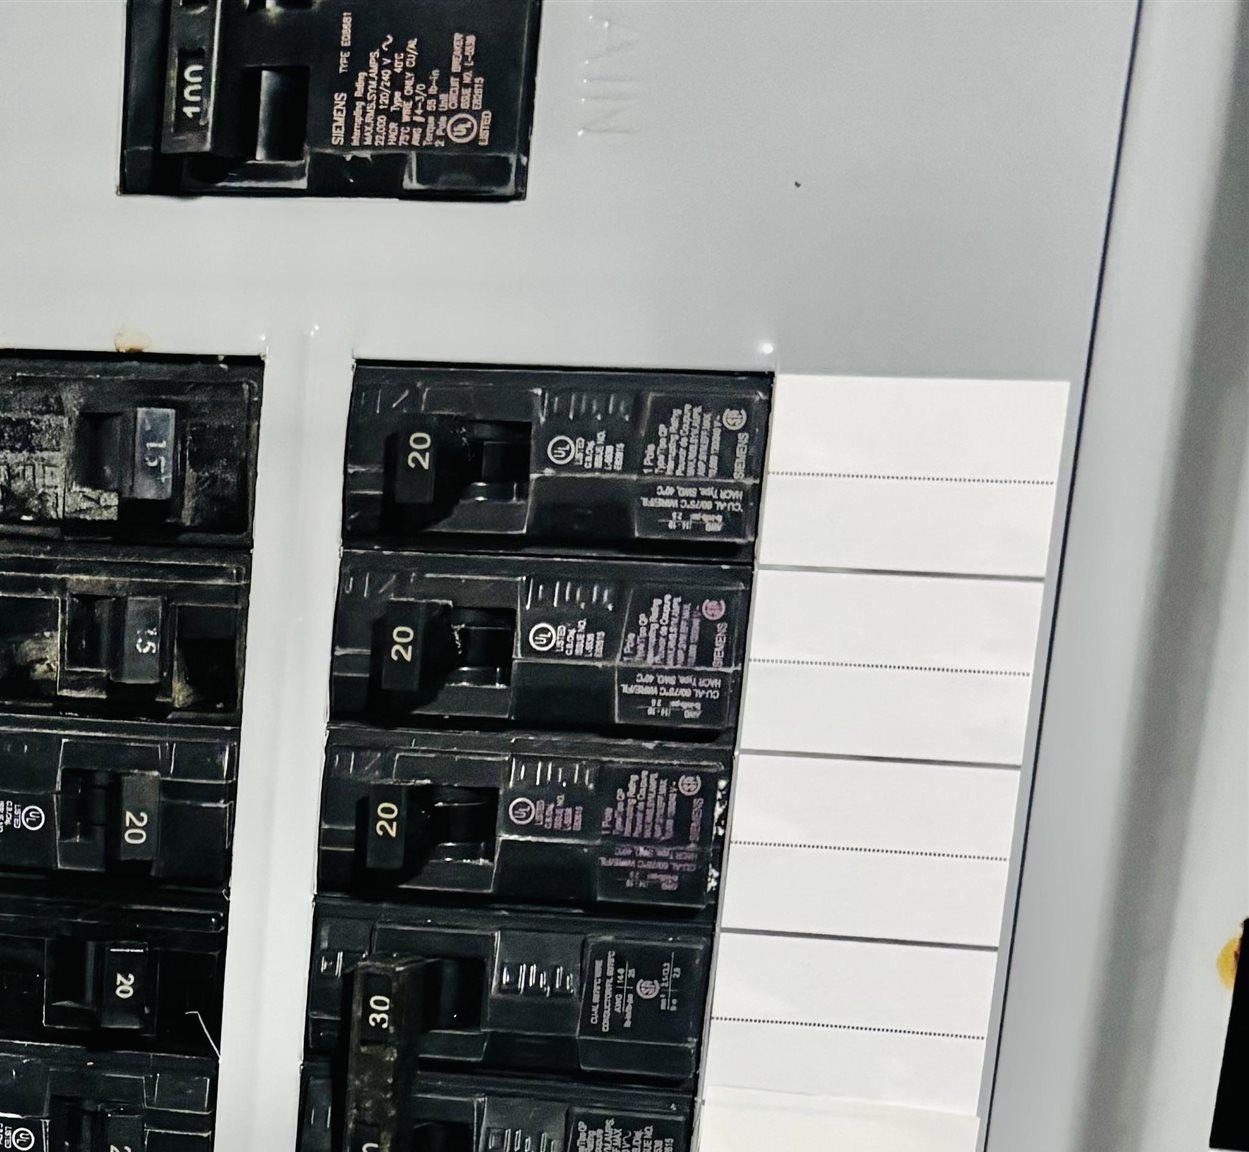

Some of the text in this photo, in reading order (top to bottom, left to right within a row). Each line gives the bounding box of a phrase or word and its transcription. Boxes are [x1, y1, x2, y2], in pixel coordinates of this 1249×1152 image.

[183, 64, 204, 118] 100
[389, 90, 403, 111] Type
[331, 92, 347, 145] SIEMENS
[408, 432, 431, 470] 20
[391, 625, 415, 663] 20
[125, 811, 147, 844] 20
[375, 801, 397, 837] 20
[116, 974, 134, 998] 20
[368, 994, 389, 1030] 30
